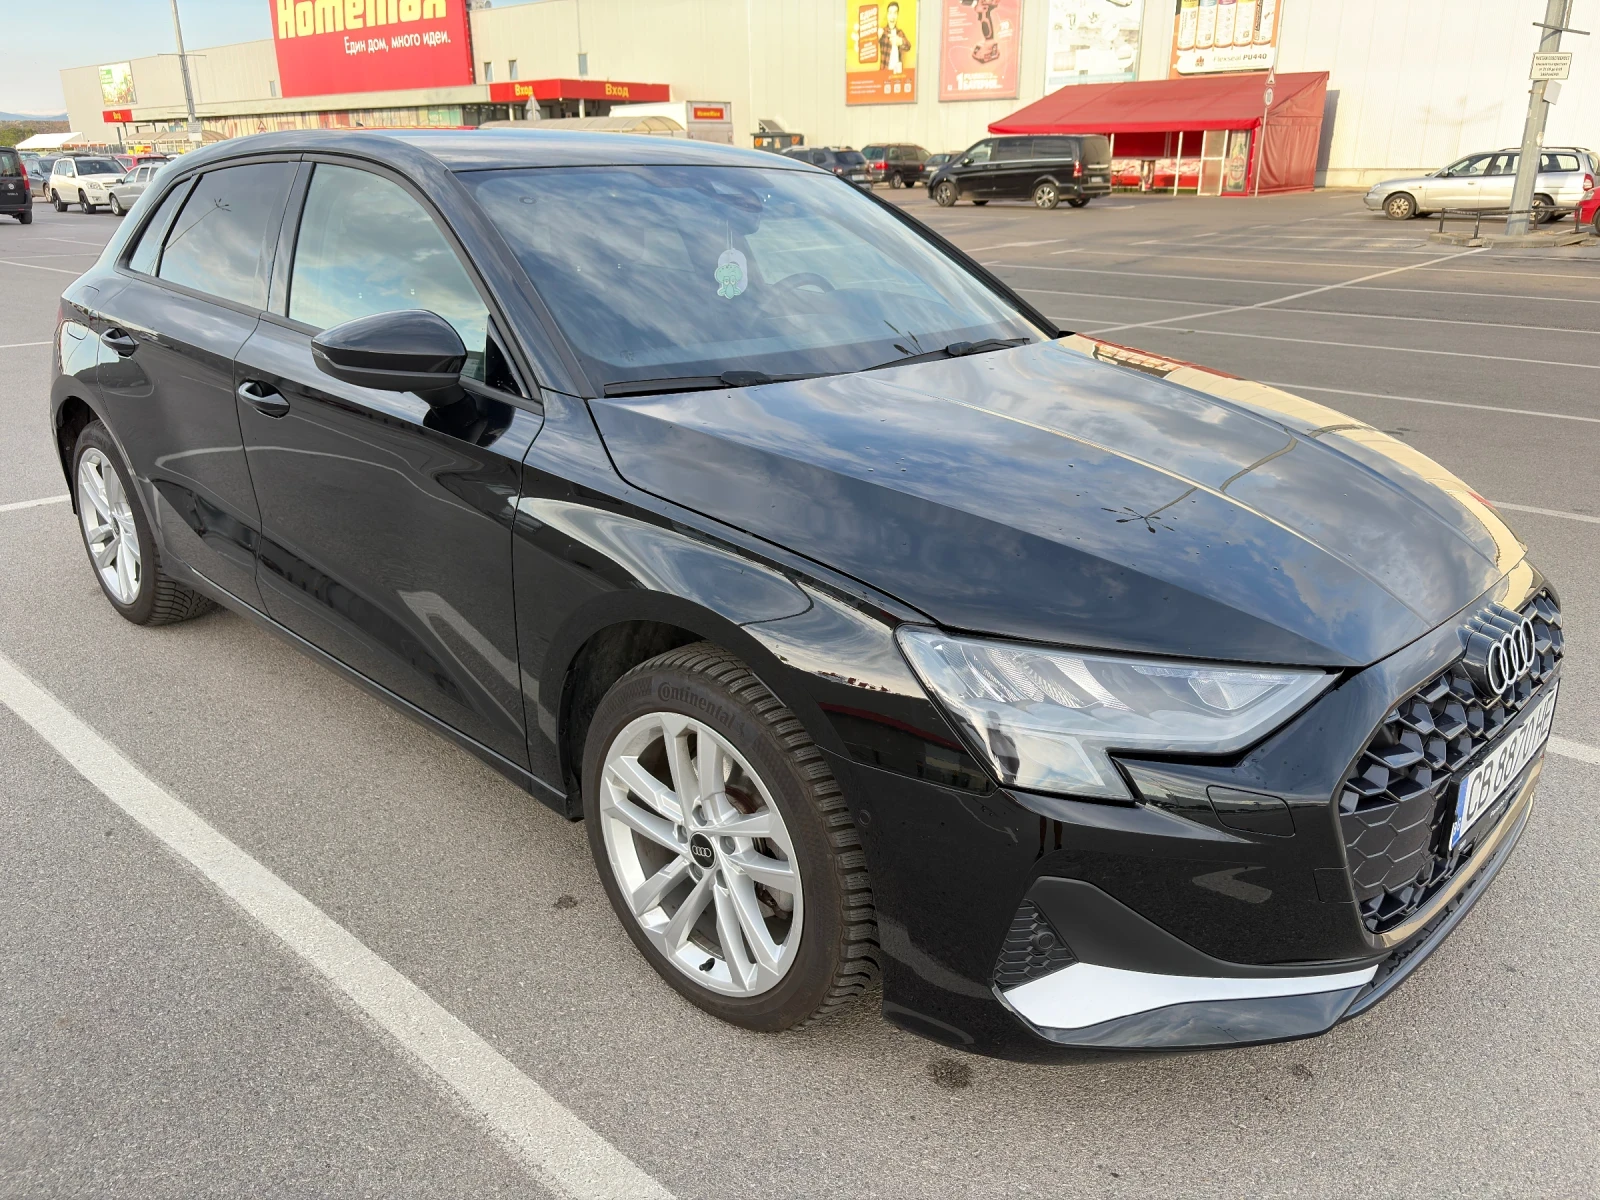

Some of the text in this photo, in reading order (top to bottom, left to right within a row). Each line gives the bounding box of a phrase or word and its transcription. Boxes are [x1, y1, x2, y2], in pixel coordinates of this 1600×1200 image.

[344, 31, 452, 55] Един дом, много идеи.
[514, 84, 533, 97] Вход
[605, 83, 629, 98] Вход
[658, 682, 736, 729] Continental
[1466, 759, 1494, 822] CB
[1493, 716, 1535, 793] 8870
